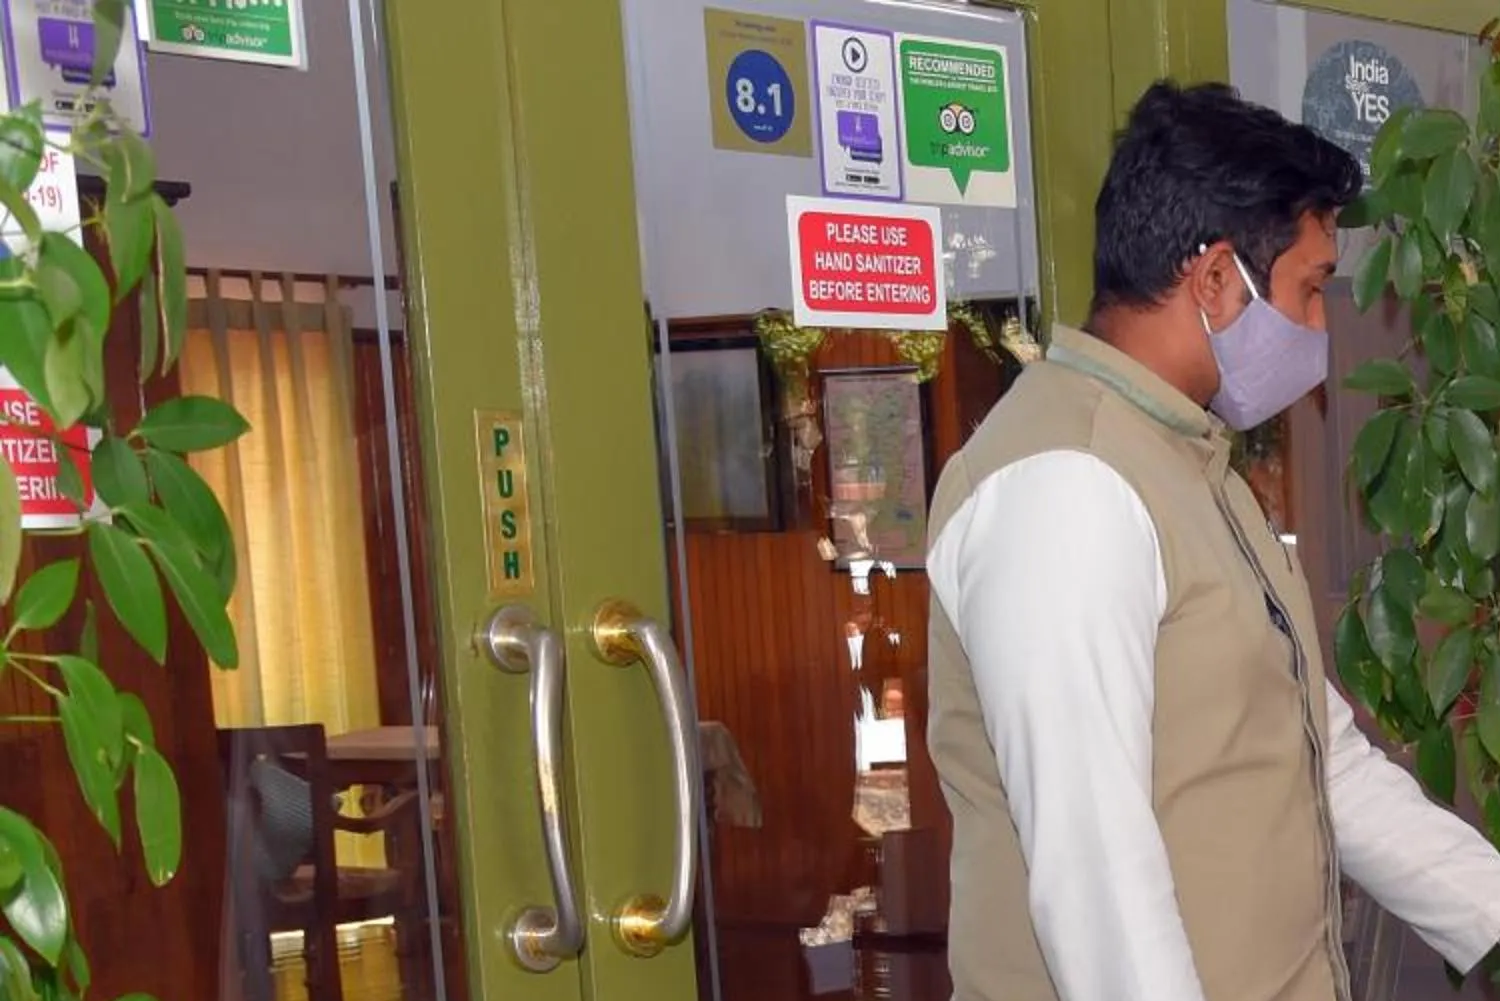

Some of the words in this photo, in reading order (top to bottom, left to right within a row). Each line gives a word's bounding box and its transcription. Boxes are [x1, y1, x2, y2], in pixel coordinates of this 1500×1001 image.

[908, 56, 995, 78] RECOMMENDED
[1350, 54, 1388, 84] India
[735, 78, 782, 116] 8.1
[1352, 91, 1389, 124] YES
[826, 222, 878, 245] PLEASE
[881, 226, 907, 246] USE
[815, 252, 852, 272] HAND
[855, 253, 922, 275] SANITIZER
[809, 280, 862, 301] BEFORE
[866, 283, 930, 304] ENTERING
[493, 427, 520, 579] PUSH
